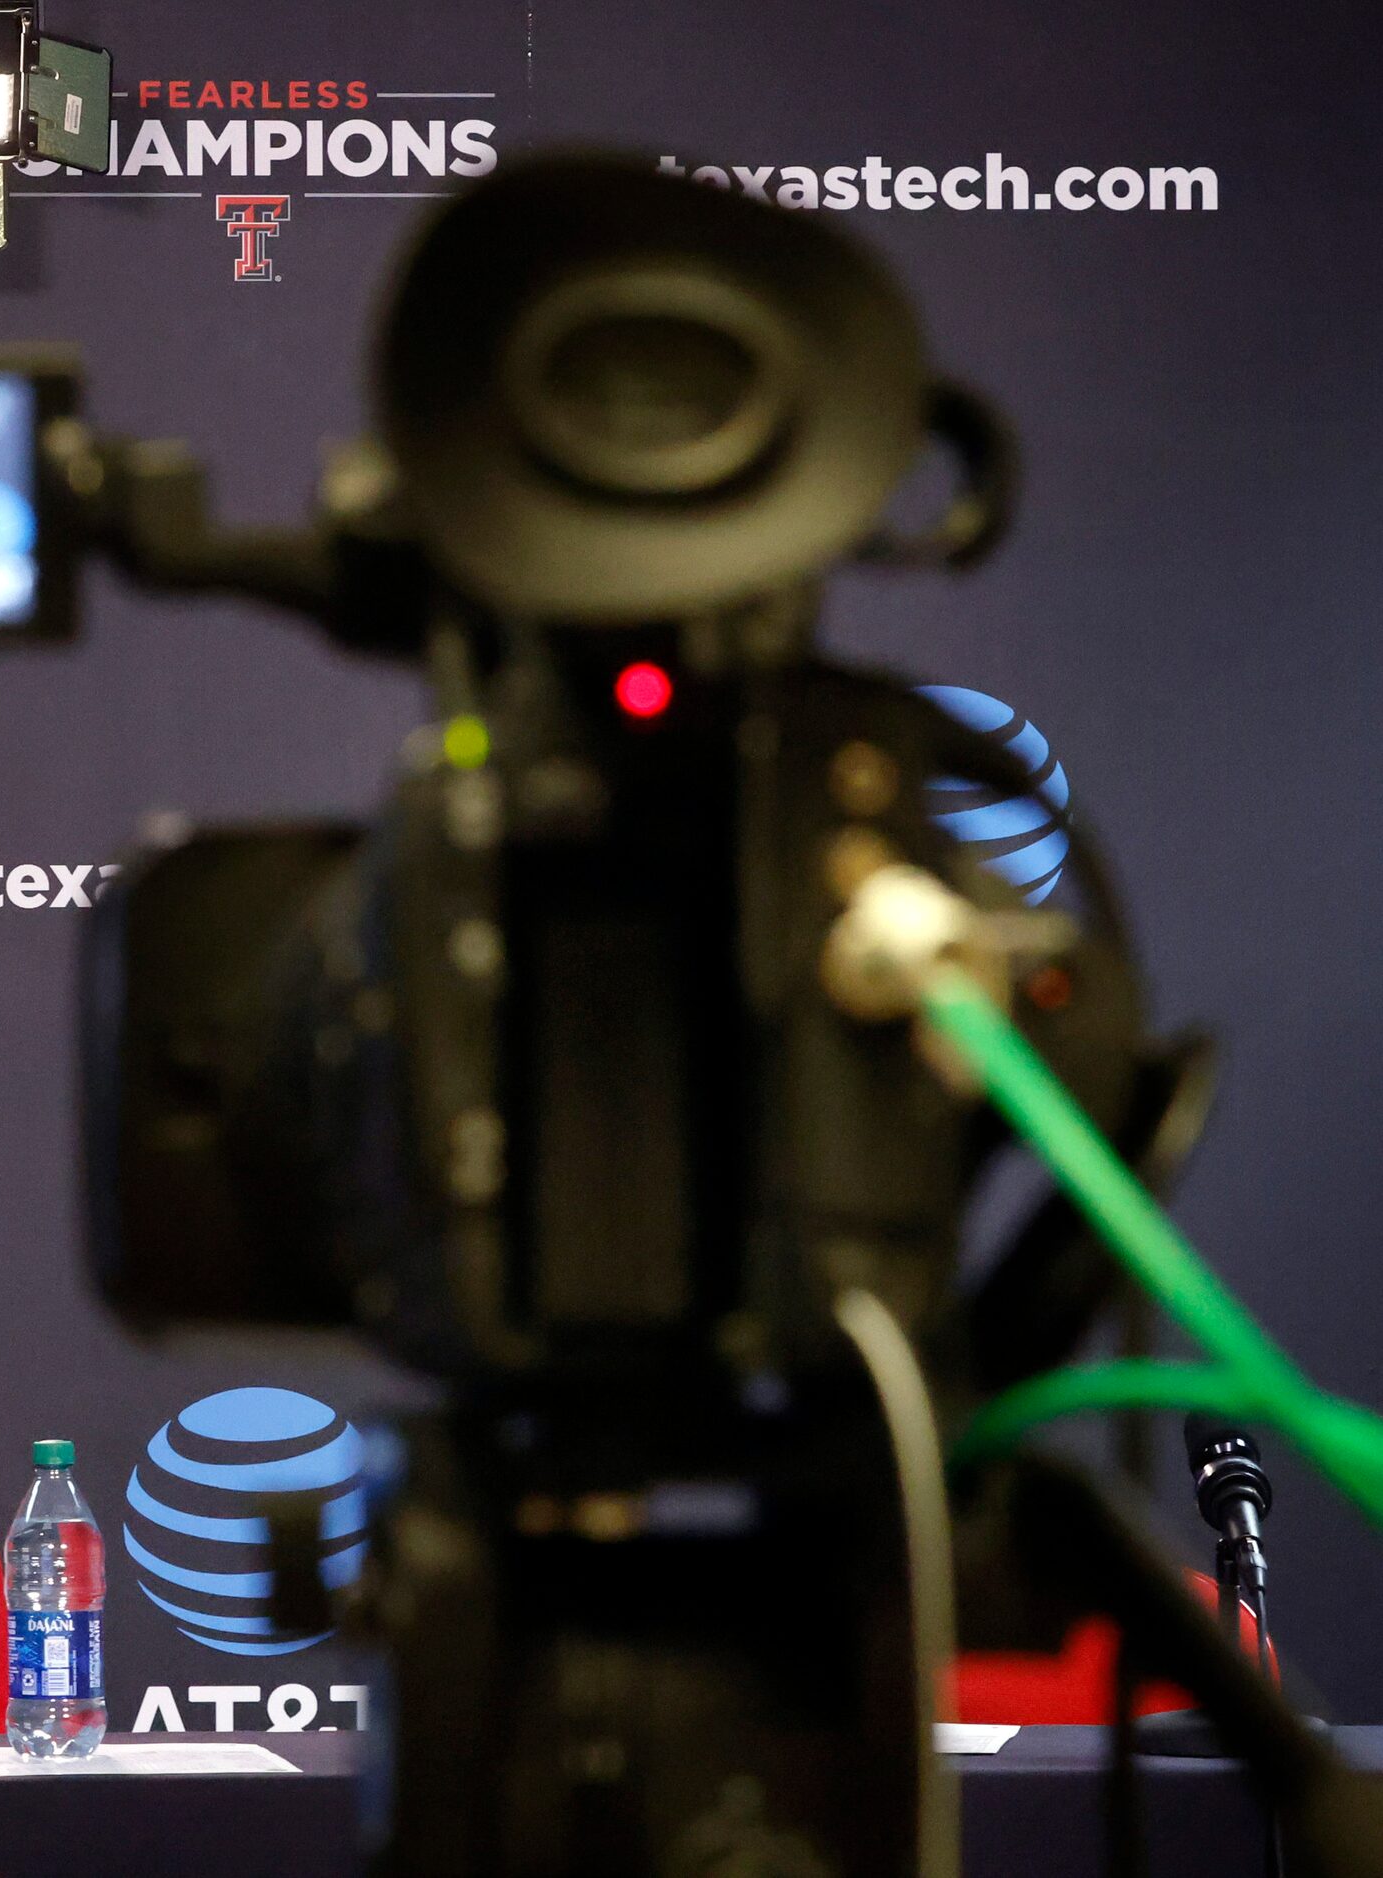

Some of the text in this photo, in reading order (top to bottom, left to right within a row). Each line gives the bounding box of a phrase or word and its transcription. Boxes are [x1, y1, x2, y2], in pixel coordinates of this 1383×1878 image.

[139, 80, 369, 109] FEARLESS
[12, 118, 498, 178] AMPIONS
[27, 1616, 76, 1634] DASANI
